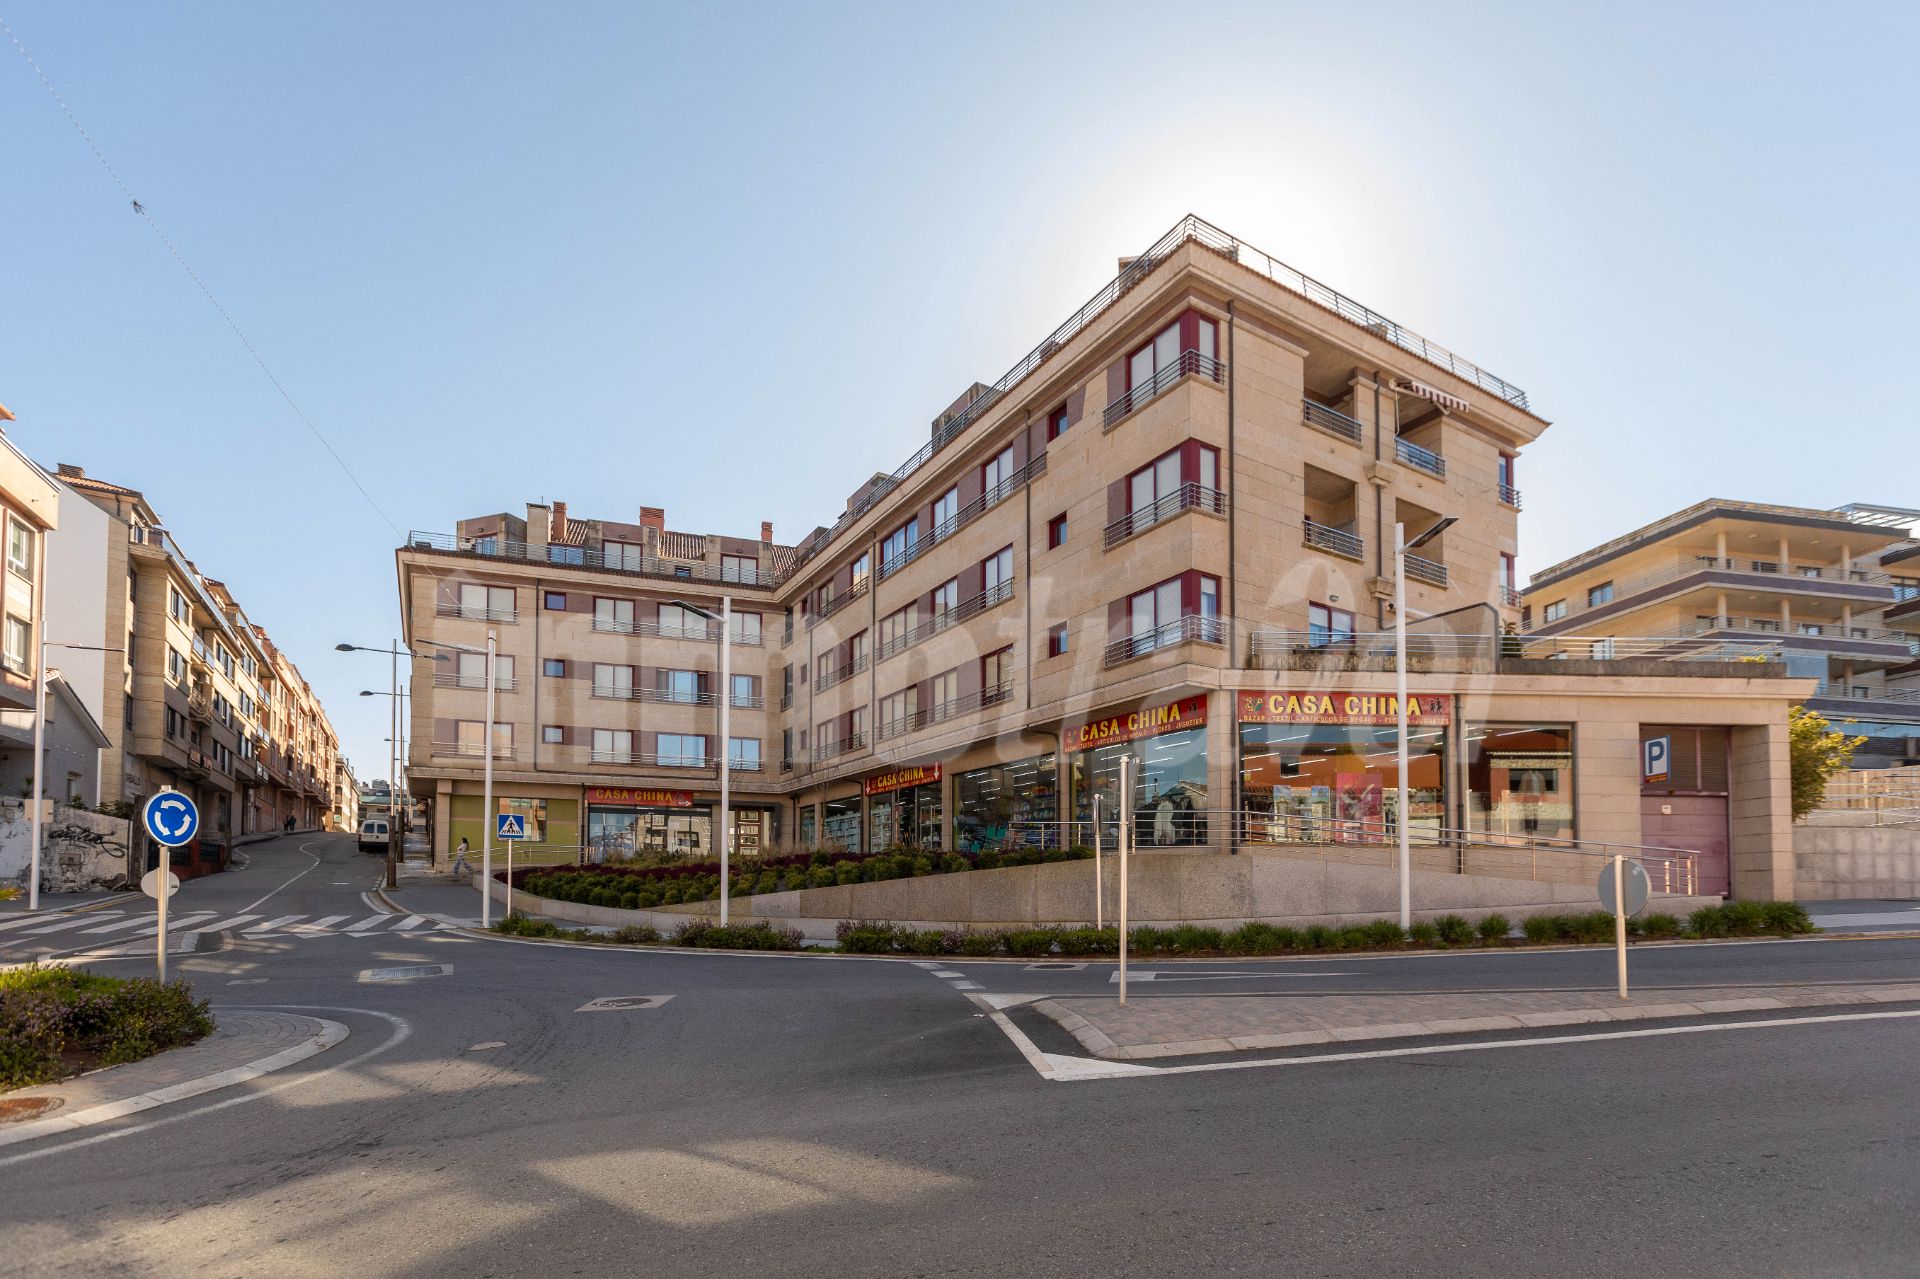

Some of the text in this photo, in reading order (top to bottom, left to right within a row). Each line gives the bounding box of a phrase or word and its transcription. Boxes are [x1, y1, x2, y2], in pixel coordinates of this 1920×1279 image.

[1269, 695, 1334, 714] CASA
[1080, 703, 1181, 742] CASA CHINA
[1175, 717, 1203, 729] JUGUETES
[1648, 740, 1665, 774] P
[878, 774, 897, 787] CASA
[899, 766, 924, 783] CHINA
[596, 788, 673, 801] CASA CHINA
